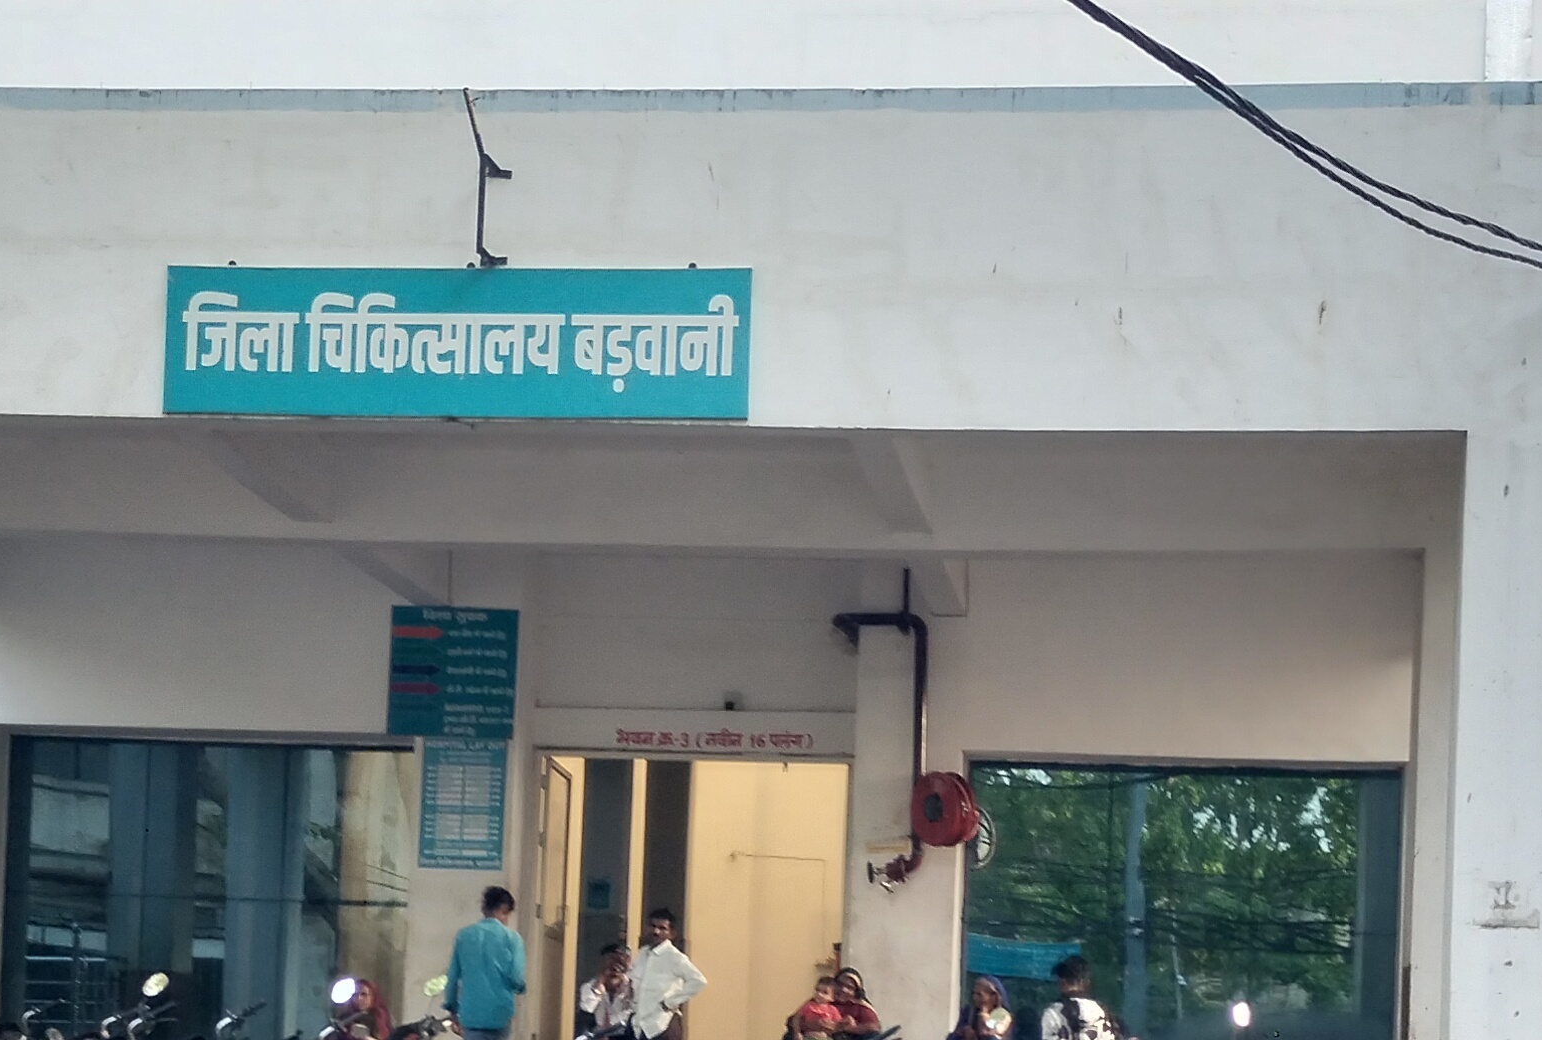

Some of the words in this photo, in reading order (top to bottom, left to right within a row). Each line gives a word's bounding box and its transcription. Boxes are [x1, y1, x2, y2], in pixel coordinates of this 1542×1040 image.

[183, 292, 299, 373] जिला
[305, 292, 566, 375] चिकित्सालय
[571, 294, 739, 393] बड़वानी
